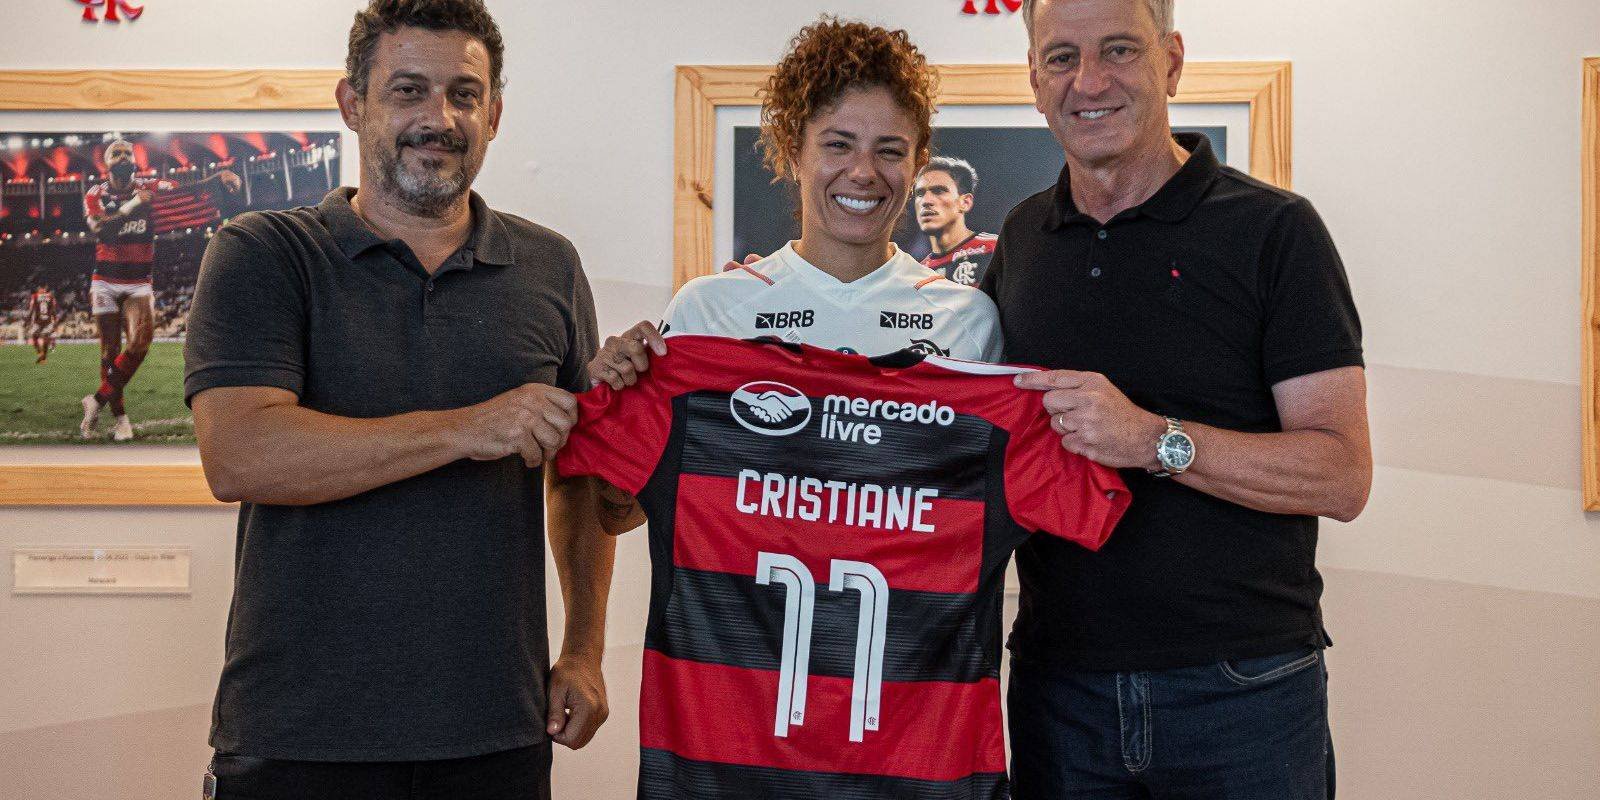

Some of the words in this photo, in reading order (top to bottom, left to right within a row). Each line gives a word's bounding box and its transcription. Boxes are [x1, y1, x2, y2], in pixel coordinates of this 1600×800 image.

[775, 310, 815, 328] BRB
[897, 313, 934, 330] BRB
[823, 394, 955, 426] mercado
[820, 413, 882, 445] livre
[735, 468, 939, 533] CRISTIANE
